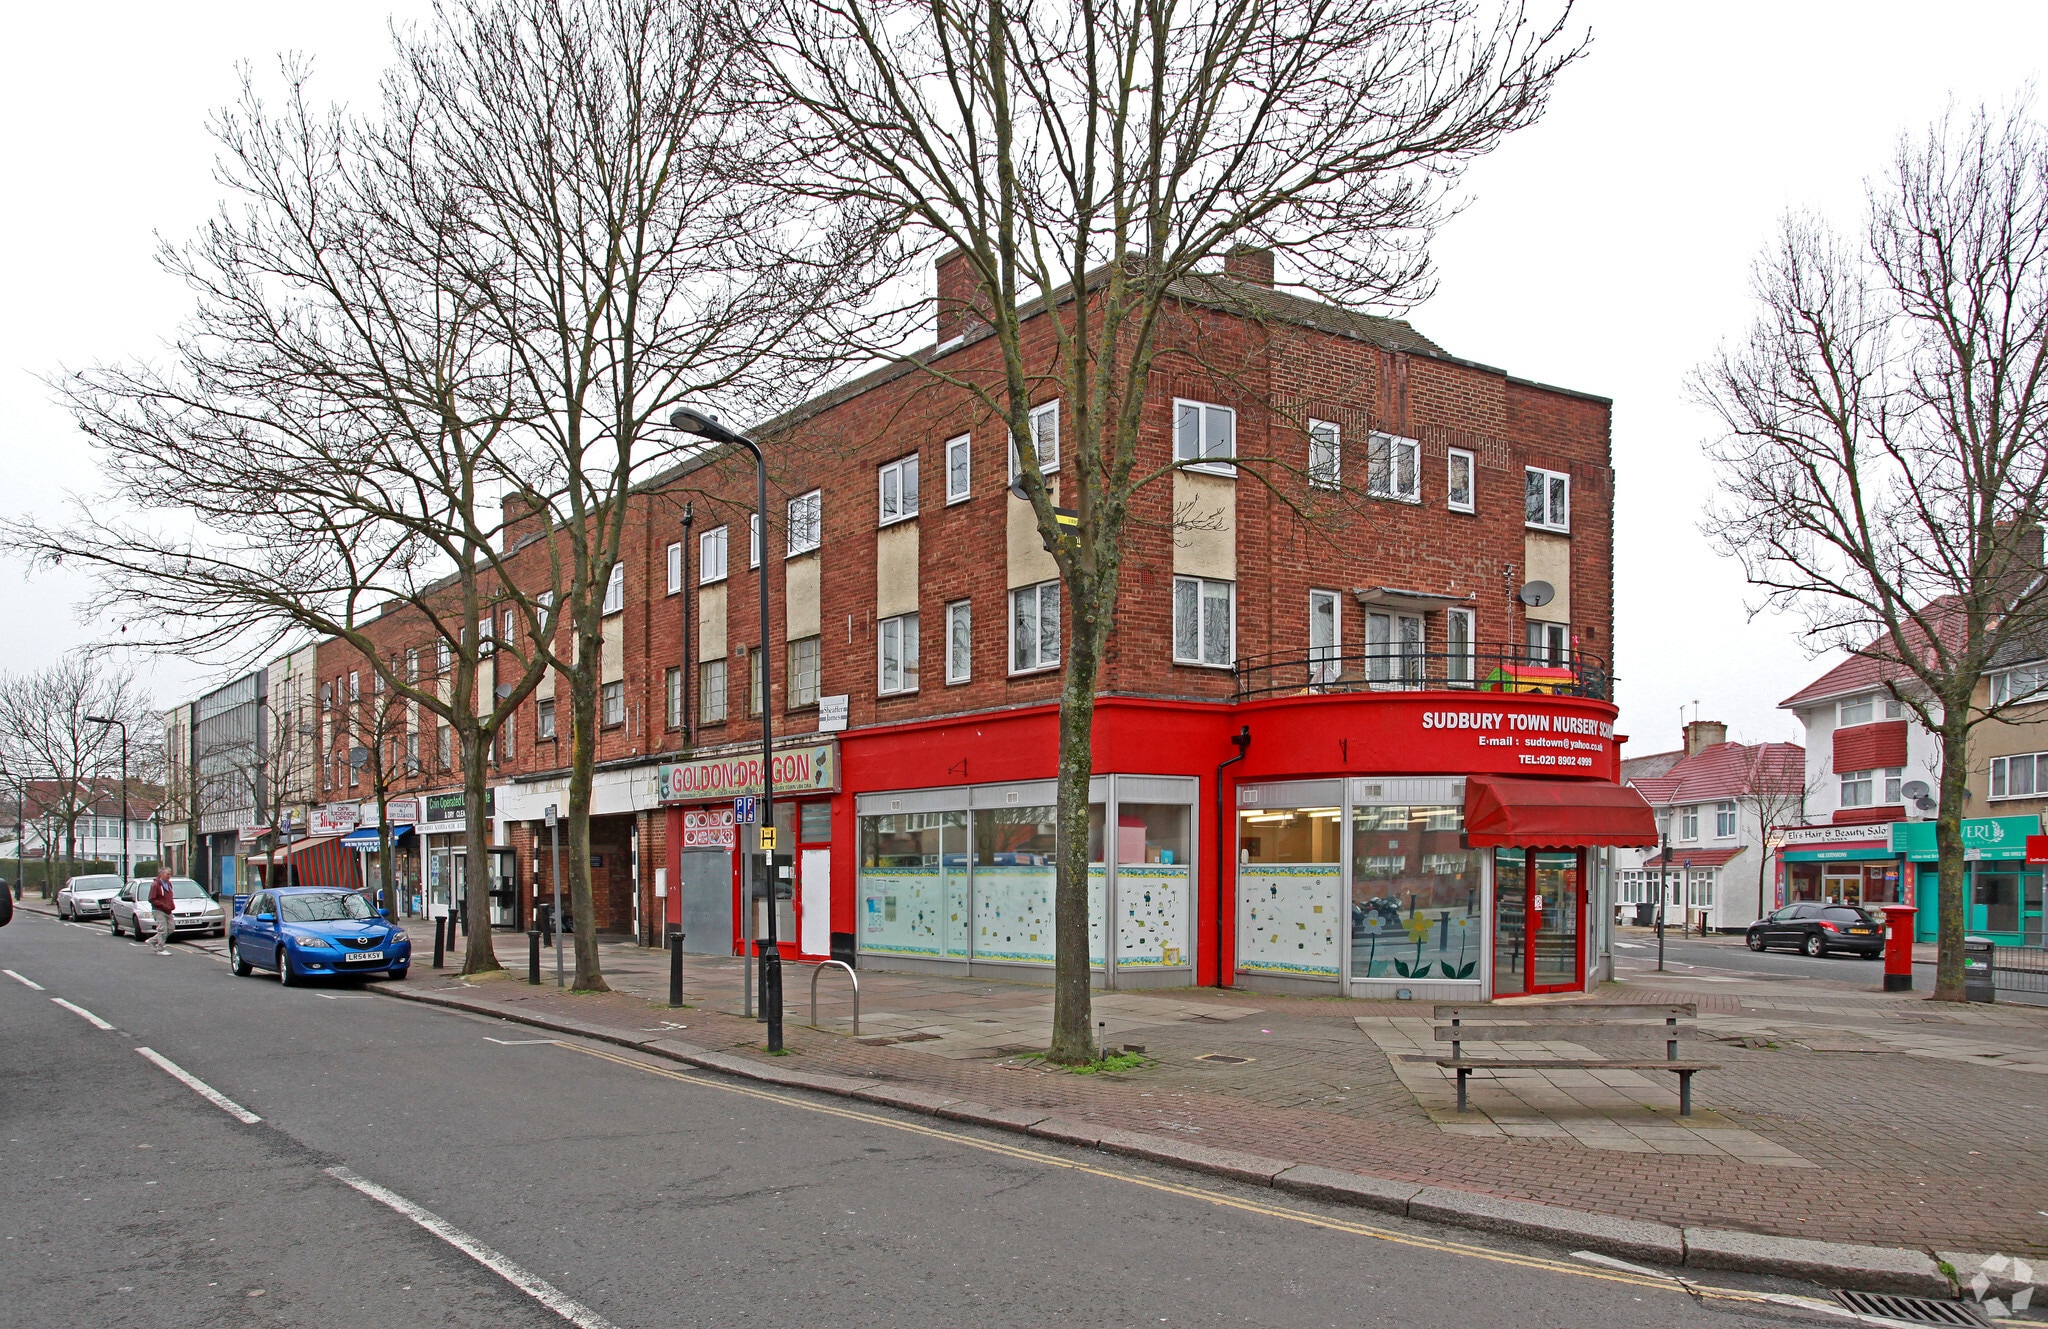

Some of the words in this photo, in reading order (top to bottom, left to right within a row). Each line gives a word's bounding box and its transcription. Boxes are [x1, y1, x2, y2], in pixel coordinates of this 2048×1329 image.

[1422, 712, 1503, 730] SUDBURY
[1507, 713, 1550, 731] TOWN
[1552, 715, 1598, 735] NURSERY
[1557, 755, 1577, 766] 8902
[1577, 756, 1593, 767] 4999
[672, 762, 734, 793] GOLDON
[430, 798, 440, 810] Coin
[440, 794, 462, 811] Operated
[447, 811, 455, 819] DRY
[1788, 831, 1803, 840] Eli's
[1804, 830, 1822, 838] Hair
[1824, 829, 1831, 838] &
[1834, 829, 1865, 838] Beauty
[348, 953, 367, 961] LR54
